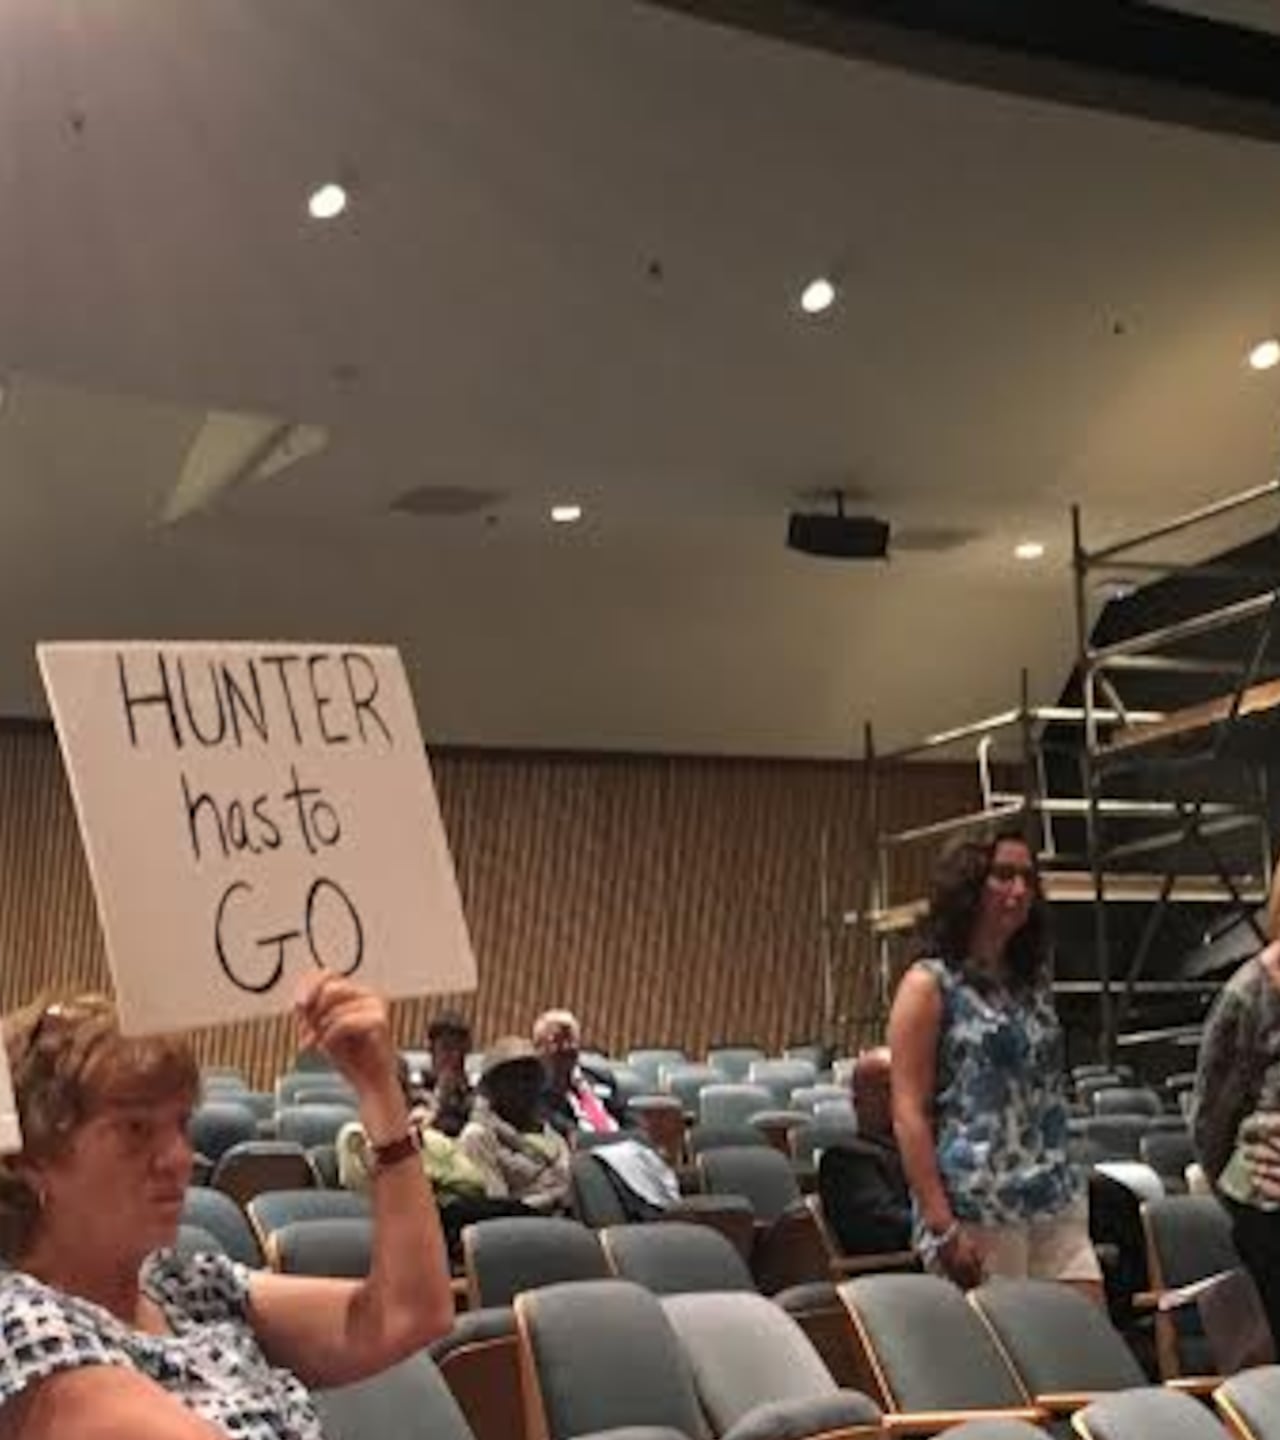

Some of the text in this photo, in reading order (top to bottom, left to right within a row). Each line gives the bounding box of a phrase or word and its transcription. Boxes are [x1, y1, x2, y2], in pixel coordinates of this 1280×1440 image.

[117, 652, 394, 750] HUNTER
[179, 764, 342, 862] has to
[214, 877, 364, 994] GO
